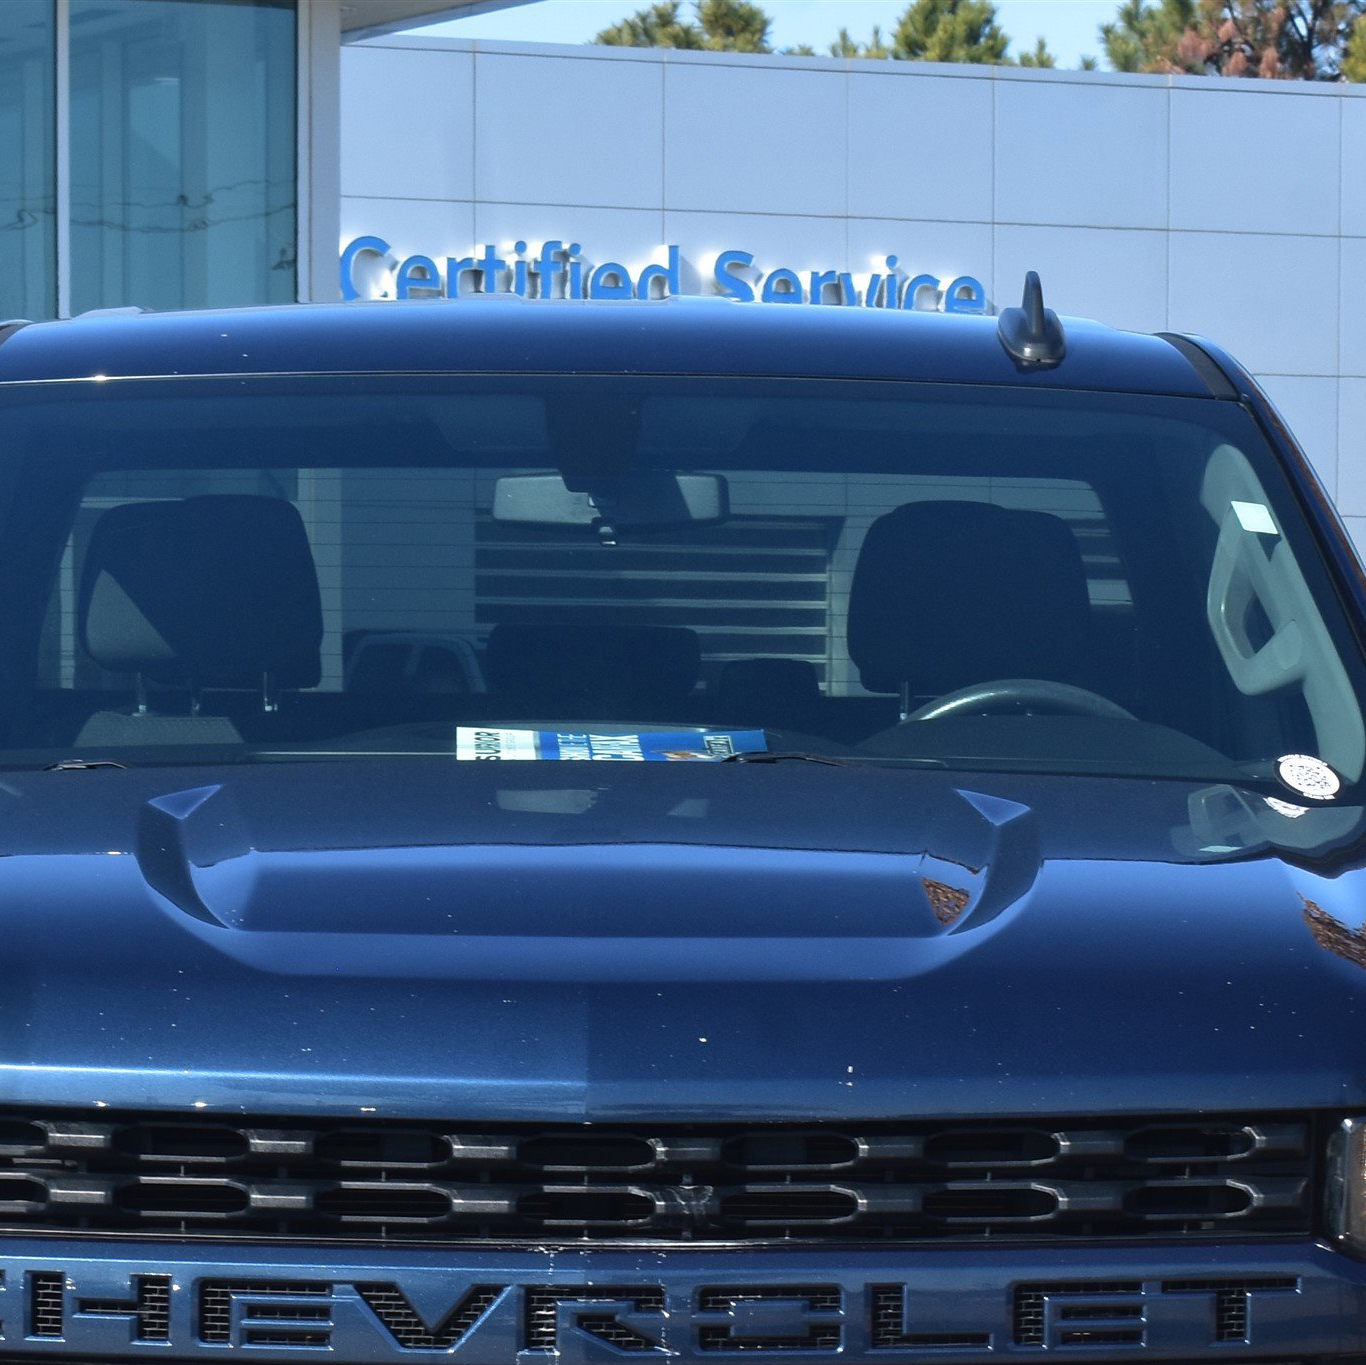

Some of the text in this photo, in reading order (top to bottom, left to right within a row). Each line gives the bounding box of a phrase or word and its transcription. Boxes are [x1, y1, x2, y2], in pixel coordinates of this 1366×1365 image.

[340, 235, 985, 315] Certified Service
[589, 734, 645, 761] CAAX
